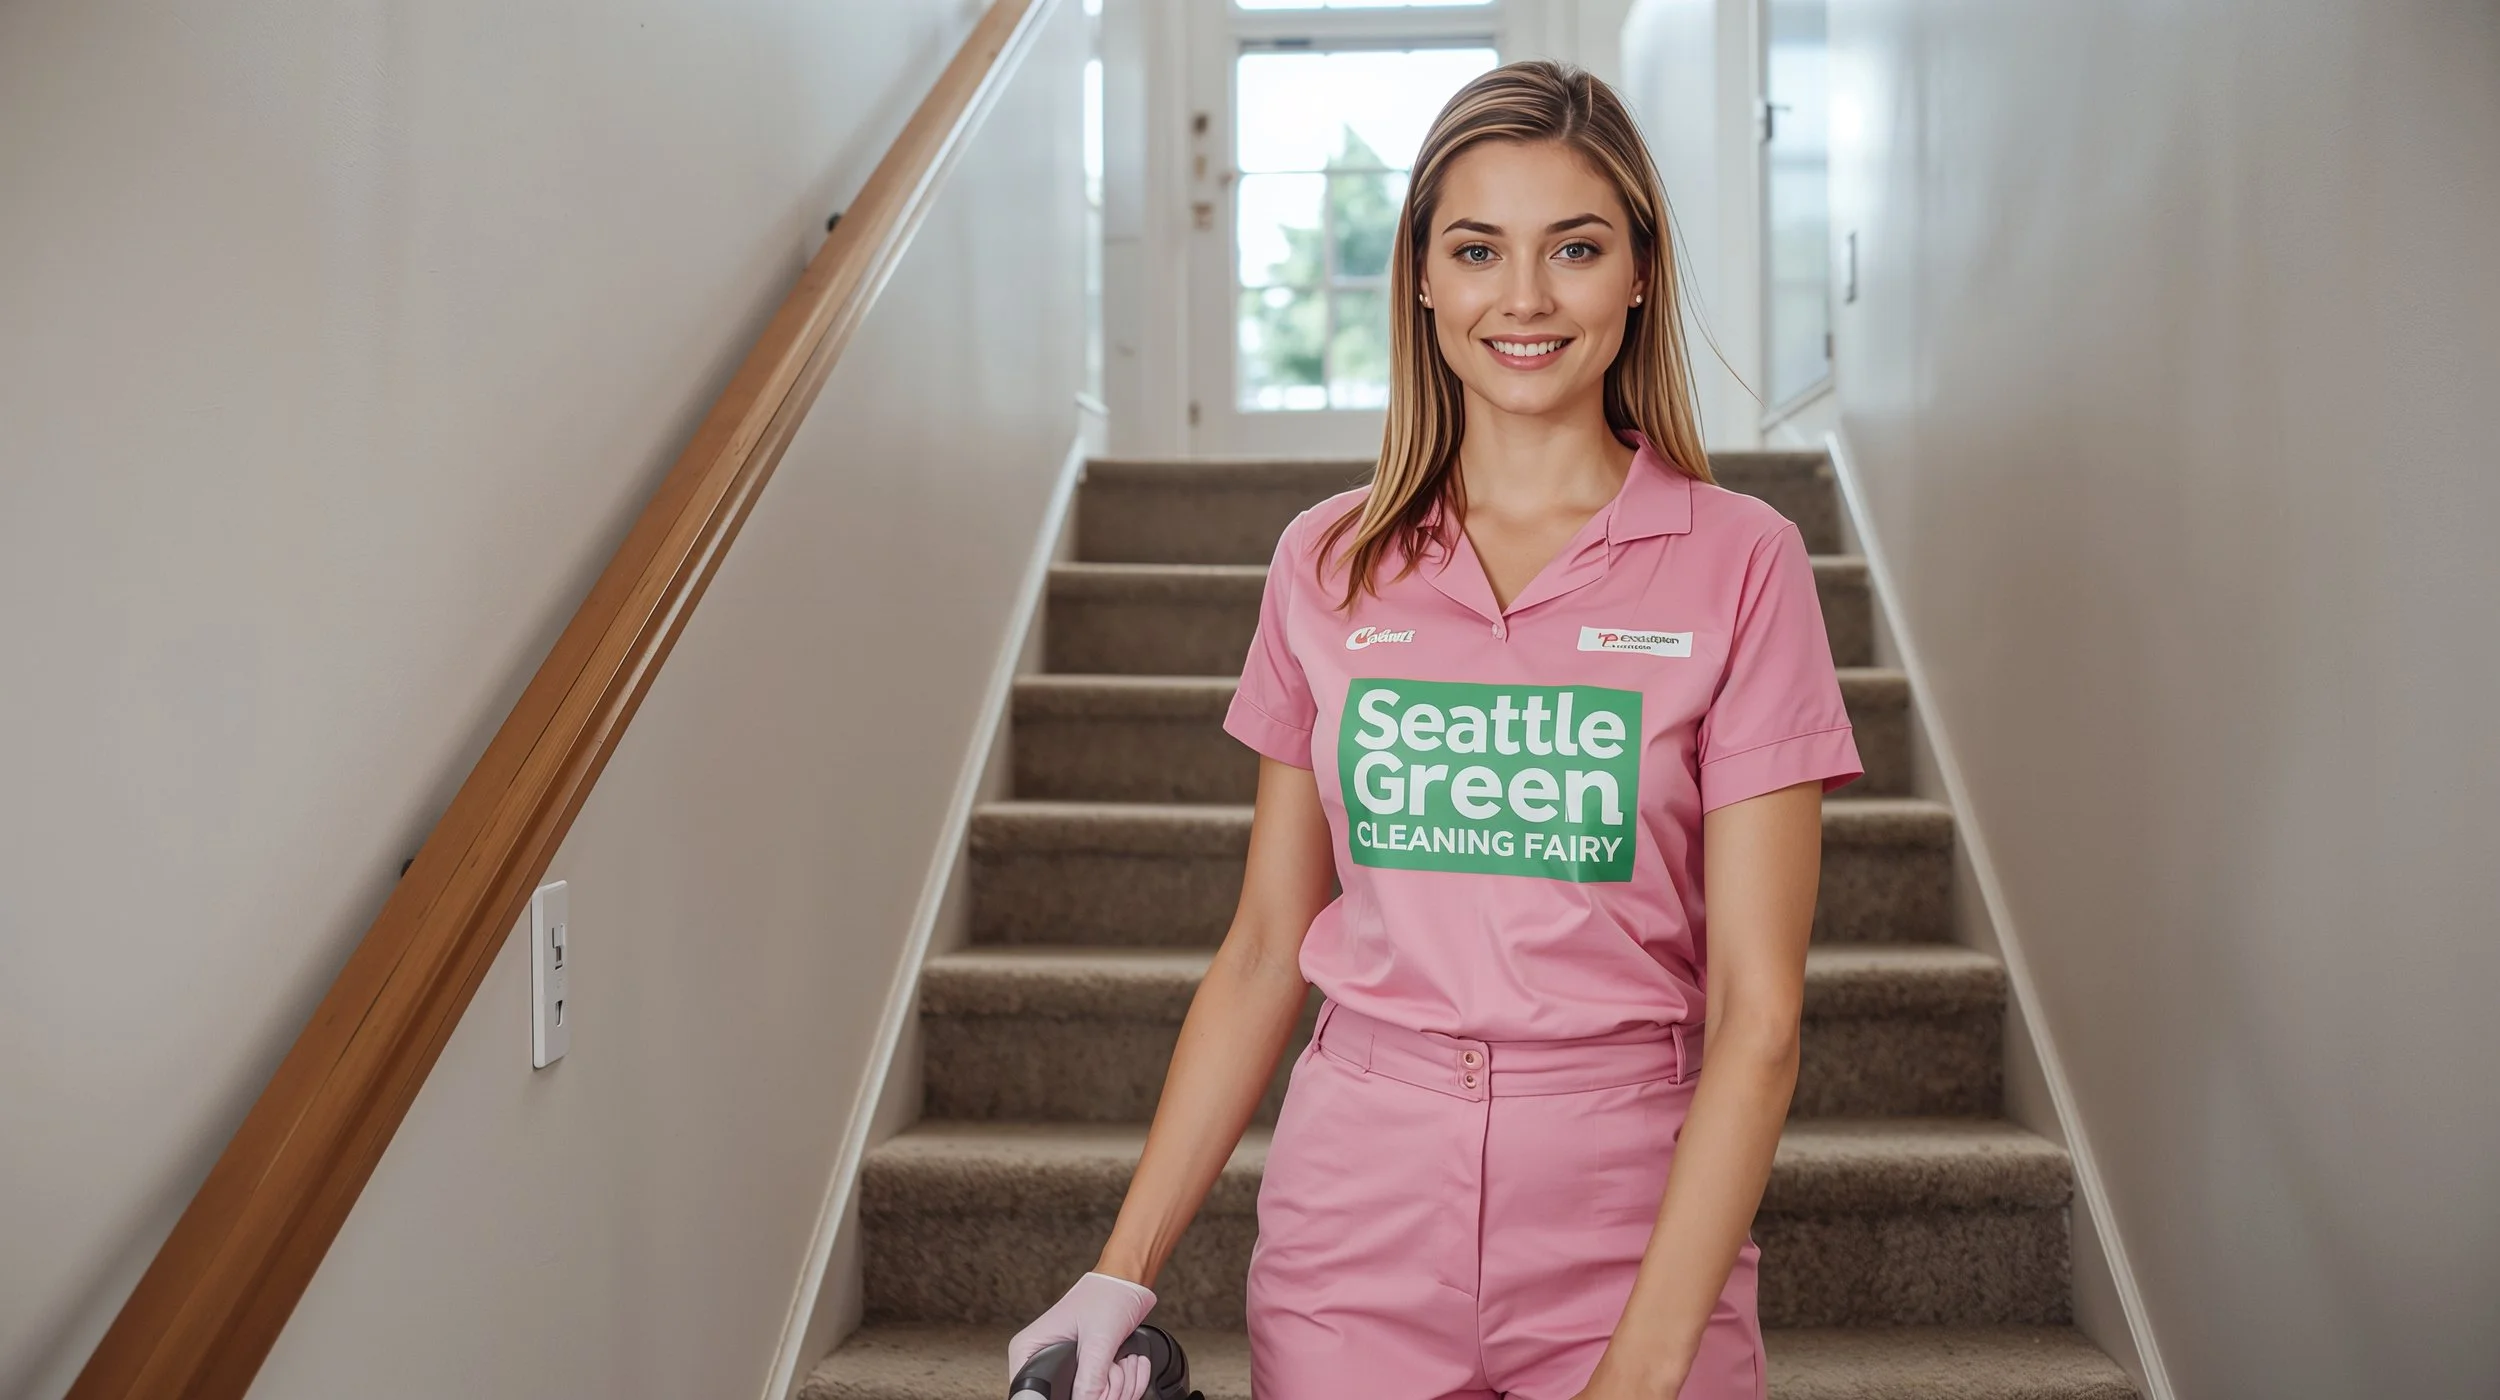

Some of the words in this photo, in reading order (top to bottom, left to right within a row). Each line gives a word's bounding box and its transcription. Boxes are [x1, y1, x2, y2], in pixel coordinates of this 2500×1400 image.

[1354, 689, 1626, 759] Seattle
[1354, 751, 1623, 825] Green
[1357, 821, 1514, 857] CLEANING
[1524, 833, 1622, 862] FAIRY
